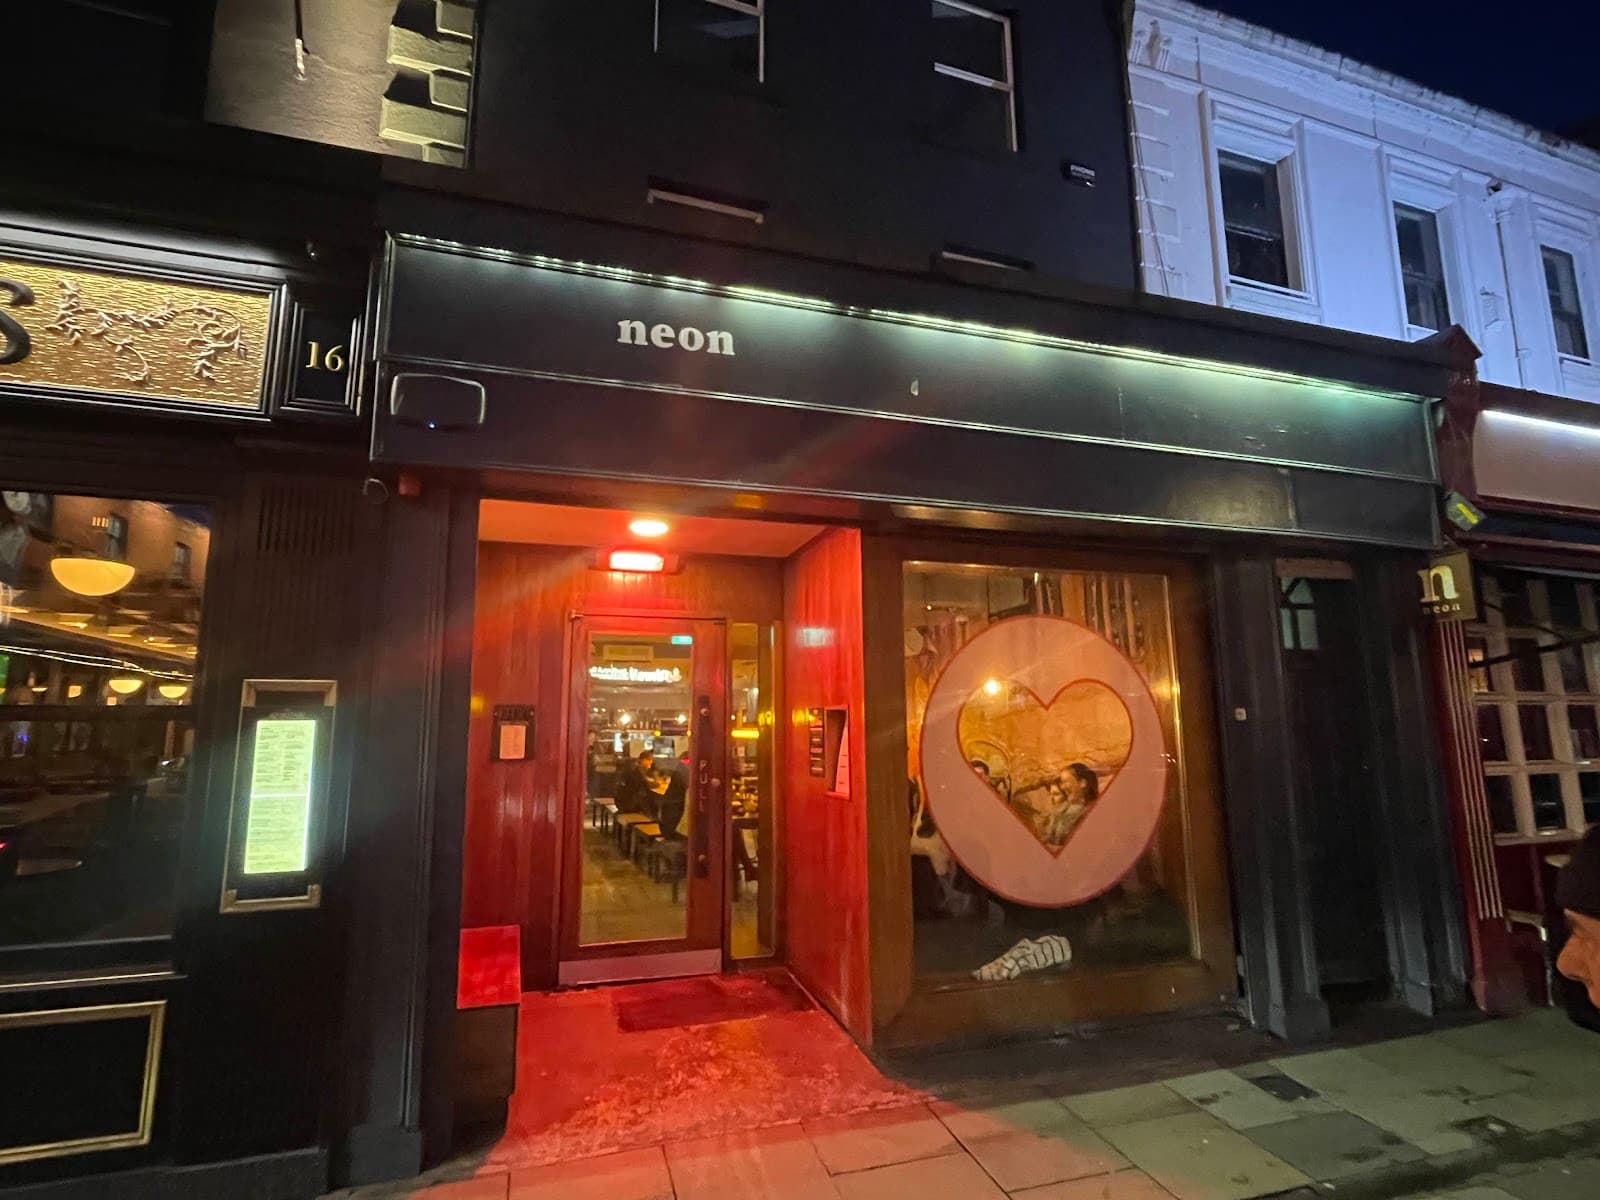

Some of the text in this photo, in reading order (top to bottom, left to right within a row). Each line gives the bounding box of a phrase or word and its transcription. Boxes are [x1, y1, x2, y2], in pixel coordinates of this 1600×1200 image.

[616, 319, 736, 356] neon
[305, 341, 344, 372] 16
[1417, 565, 1460, 603] n
[1423, 603, 1460, 614] neon
